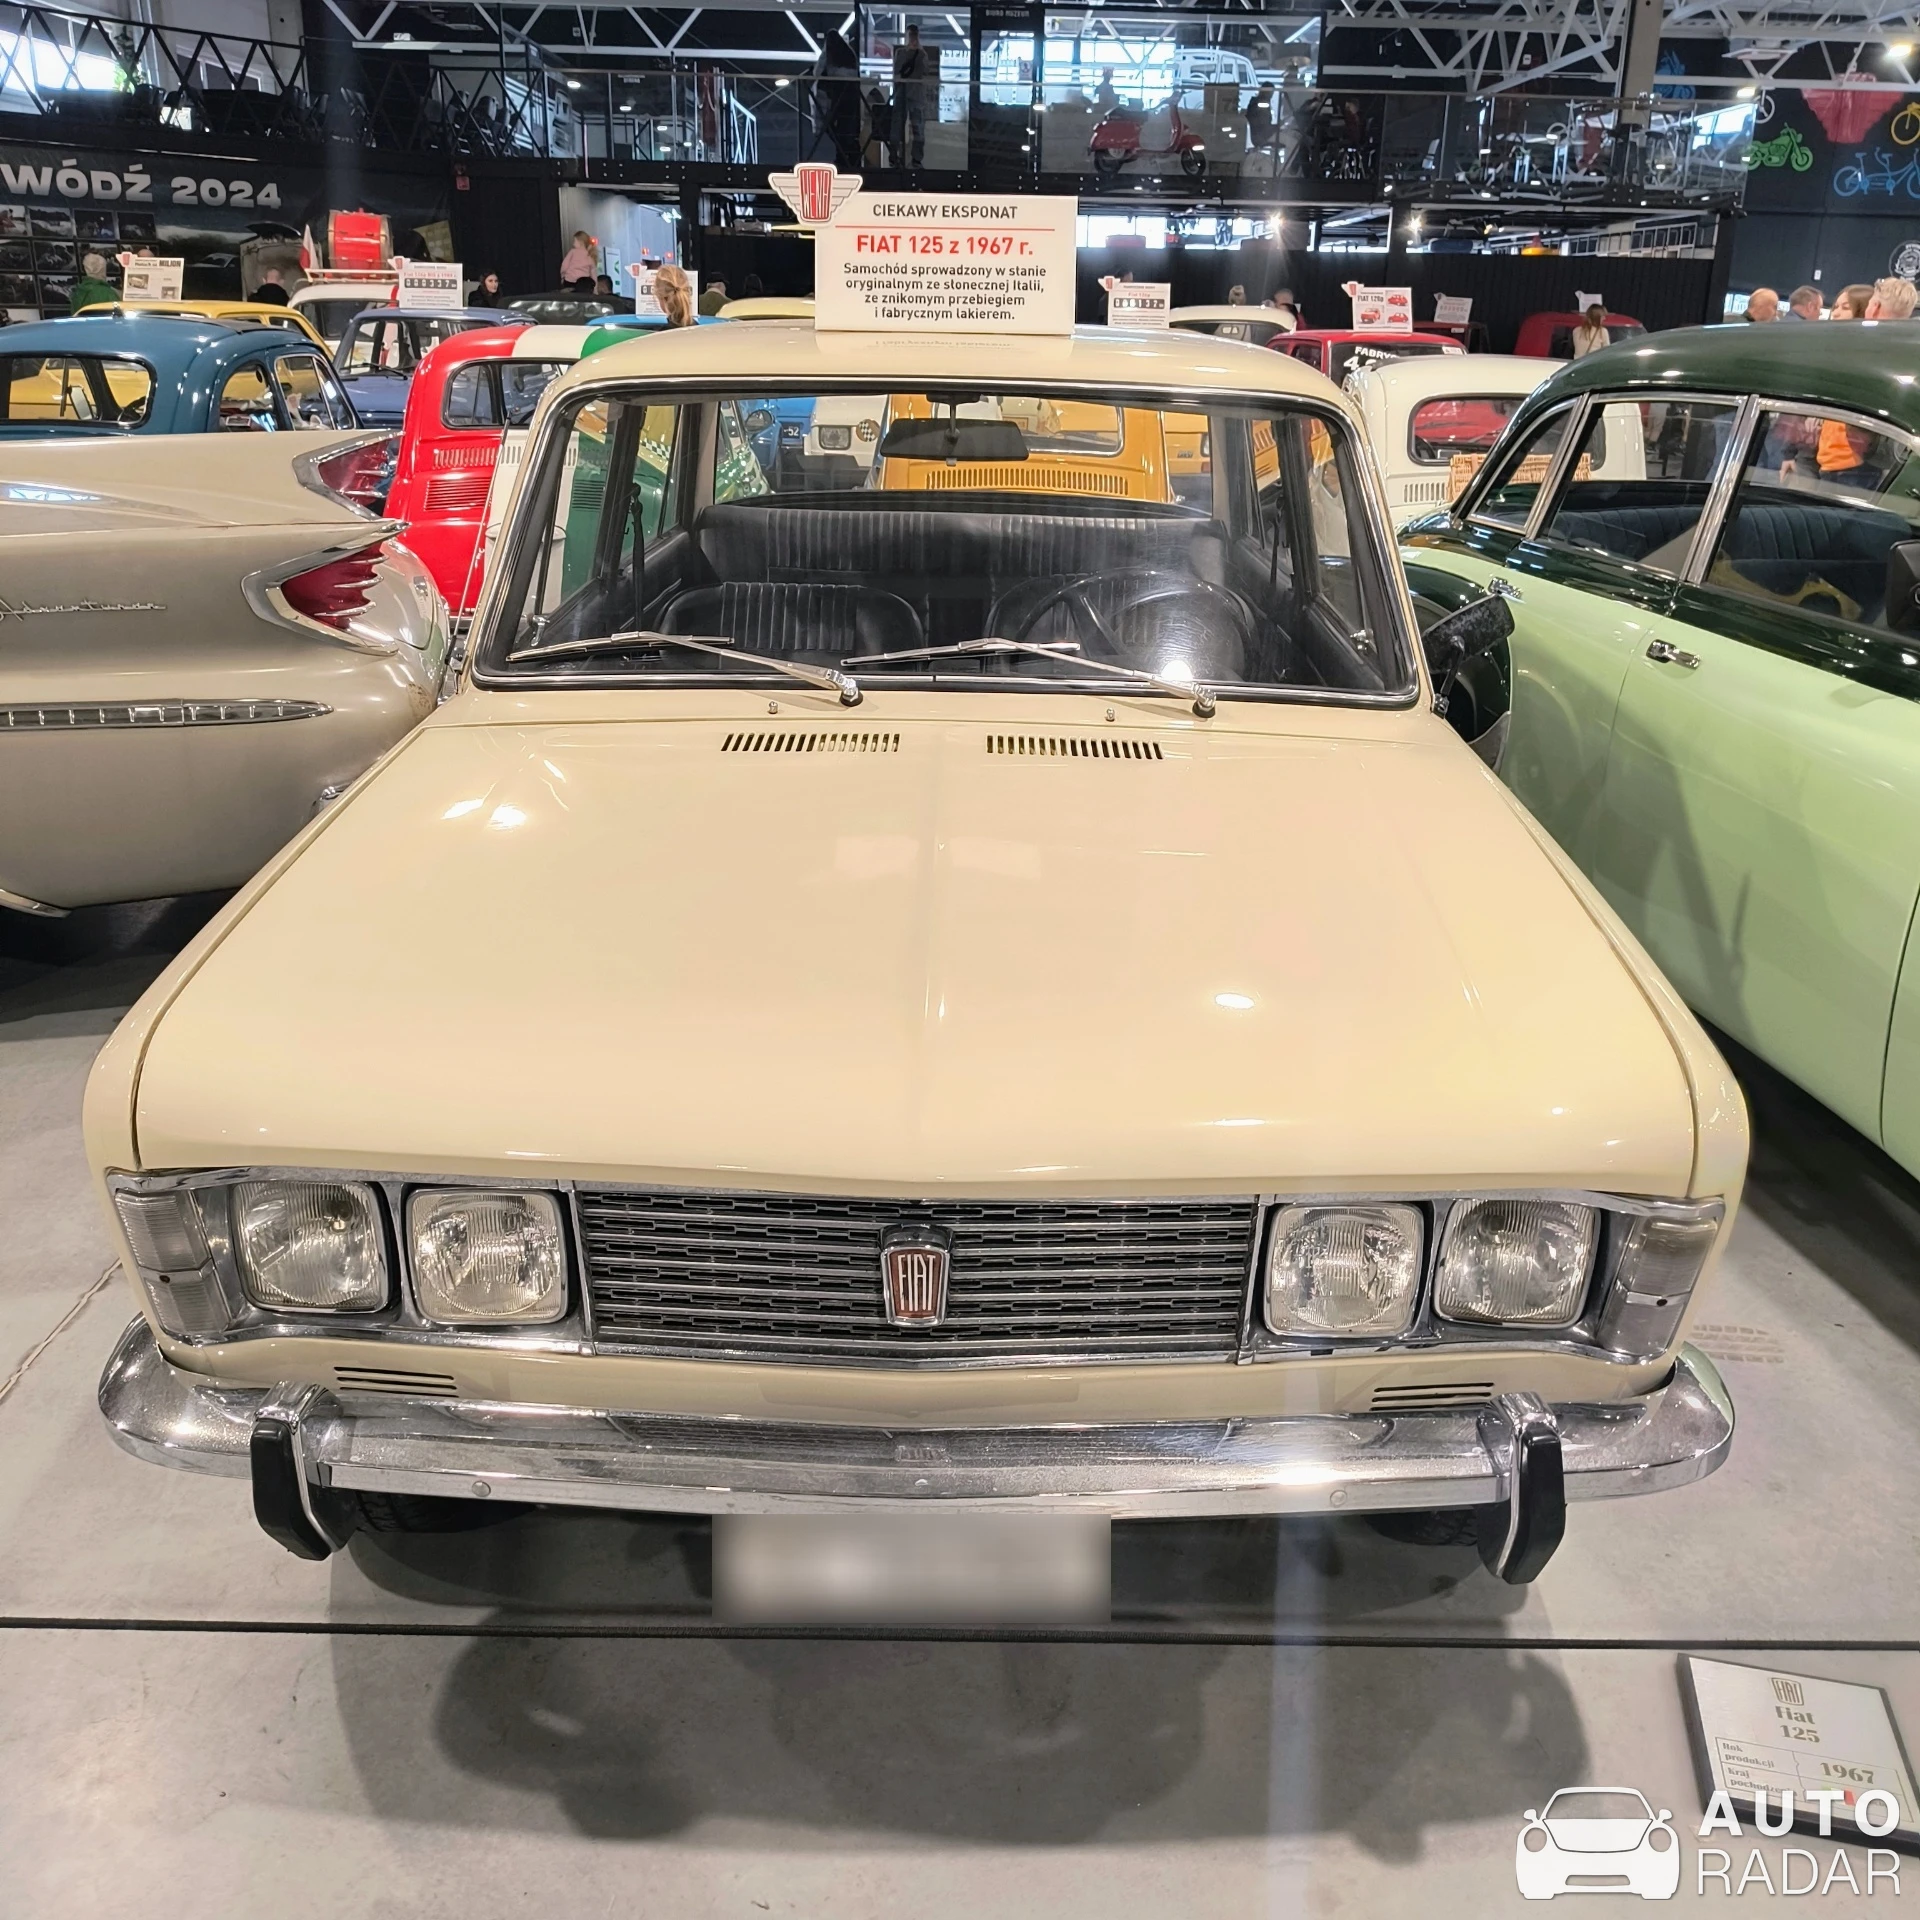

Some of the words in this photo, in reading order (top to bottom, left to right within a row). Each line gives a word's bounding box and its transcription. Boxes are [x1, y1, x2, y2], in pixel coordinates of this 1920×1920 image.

[0, 158, 153, 202] WÓDŹ
[170, 176, 282, 209] 2024
[801, 169, 830, 219] WENA
[873, 203, 938, 217] CIEKAWY
[941, 205, 1018, 219] EKSPONAT
[857, 234, 902, 253] FIAT
[908, 235, 944, 254] 125
[949, 240, 960, 254] z
[966, 236, 1014, 255] 1967
[1019, 241, 1034, 255] r.
[843, 262, 908, 275] Samochód
[911, 264, 993, 278] sprowadzony
[995, 268, 1006, 276] w
[1008, 265, 1047, 277] stanie
[845, 277, 923, 292] oryginalnym
[926, 280, 941, 290] ze
[943, 279, 1010, 293] słonecznej
[1013, 280, 1045, 293] Italii,
[864, 293, 879, 304] ze
[881, 292, 945, 307] znikomym
[948, 293, 1026, 308] przebiegiem
[874, 307, 879, 318] i
[881, 307, 953, 321] fabrycznym
[956, 308, 1016, 320] lakierem.
[897, 1253, 936, 1312] FIAT
[1776, 1678, 1803, 1704] FIAT
[1774, 1705, 1816, 1725] Fiat
[1779, 1724, 1821, 1743] 125
[1722, 1742, 1744, 1753] Rok
[1724, 1752, 1775, 1768] produkcji
[1727, 1767, 1751, 1779] Kraj
[1819, 1761, 1875, 1785] 1967
[1729, 1777, 1798, 1797] pochodzen
